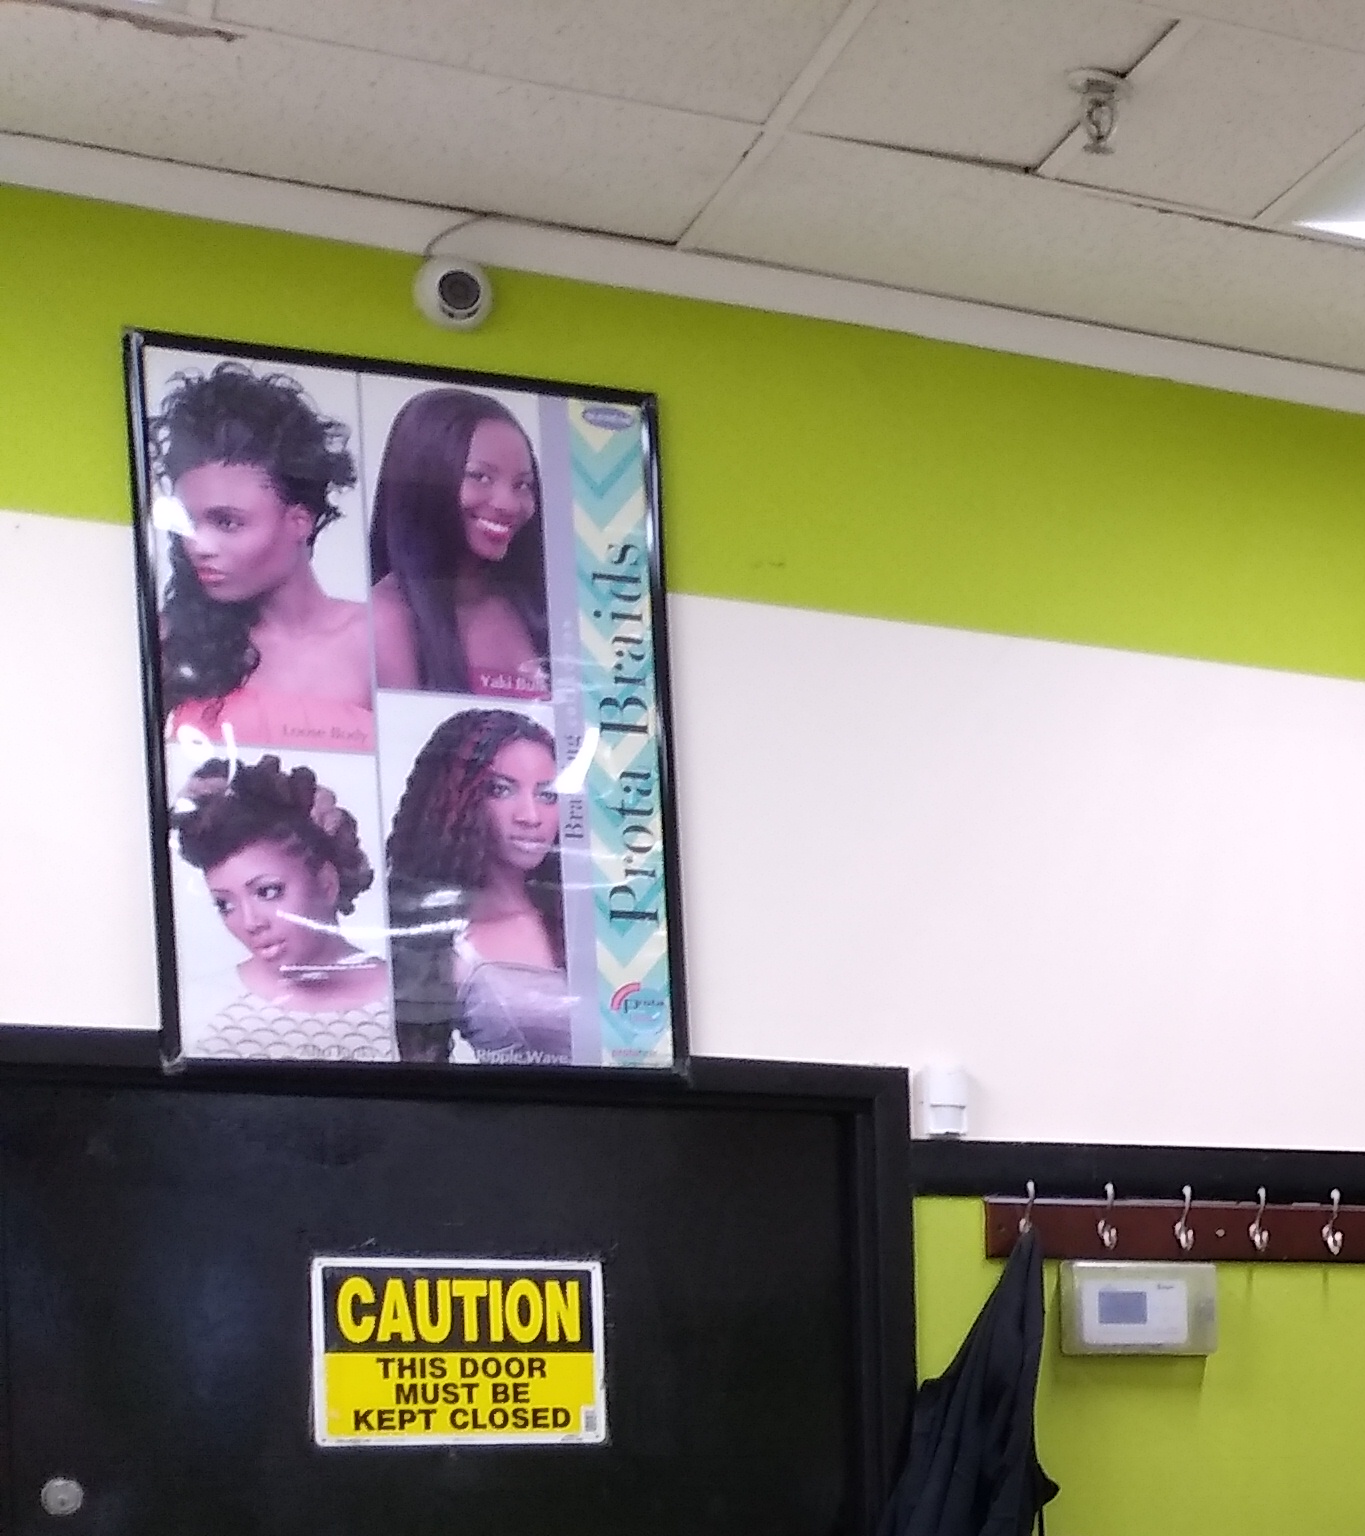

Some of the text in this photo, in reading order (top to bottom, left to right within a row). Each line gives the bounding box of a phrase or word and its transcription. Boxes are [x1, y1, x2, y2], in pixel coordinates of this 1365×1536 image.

[592, 544, 659, 922] Prota Braids
[565, 735, 584, 838] Brang
[524, 1050, 570, 1064] Wave
[337, 1275, 581, 1343] CAUTION
[376, 1357, 547, 1379] THIS DOOR
[395, 1383, 530, 1404] MUST BE
[353, 1408, 571, 1430] KEPT CLOSED
